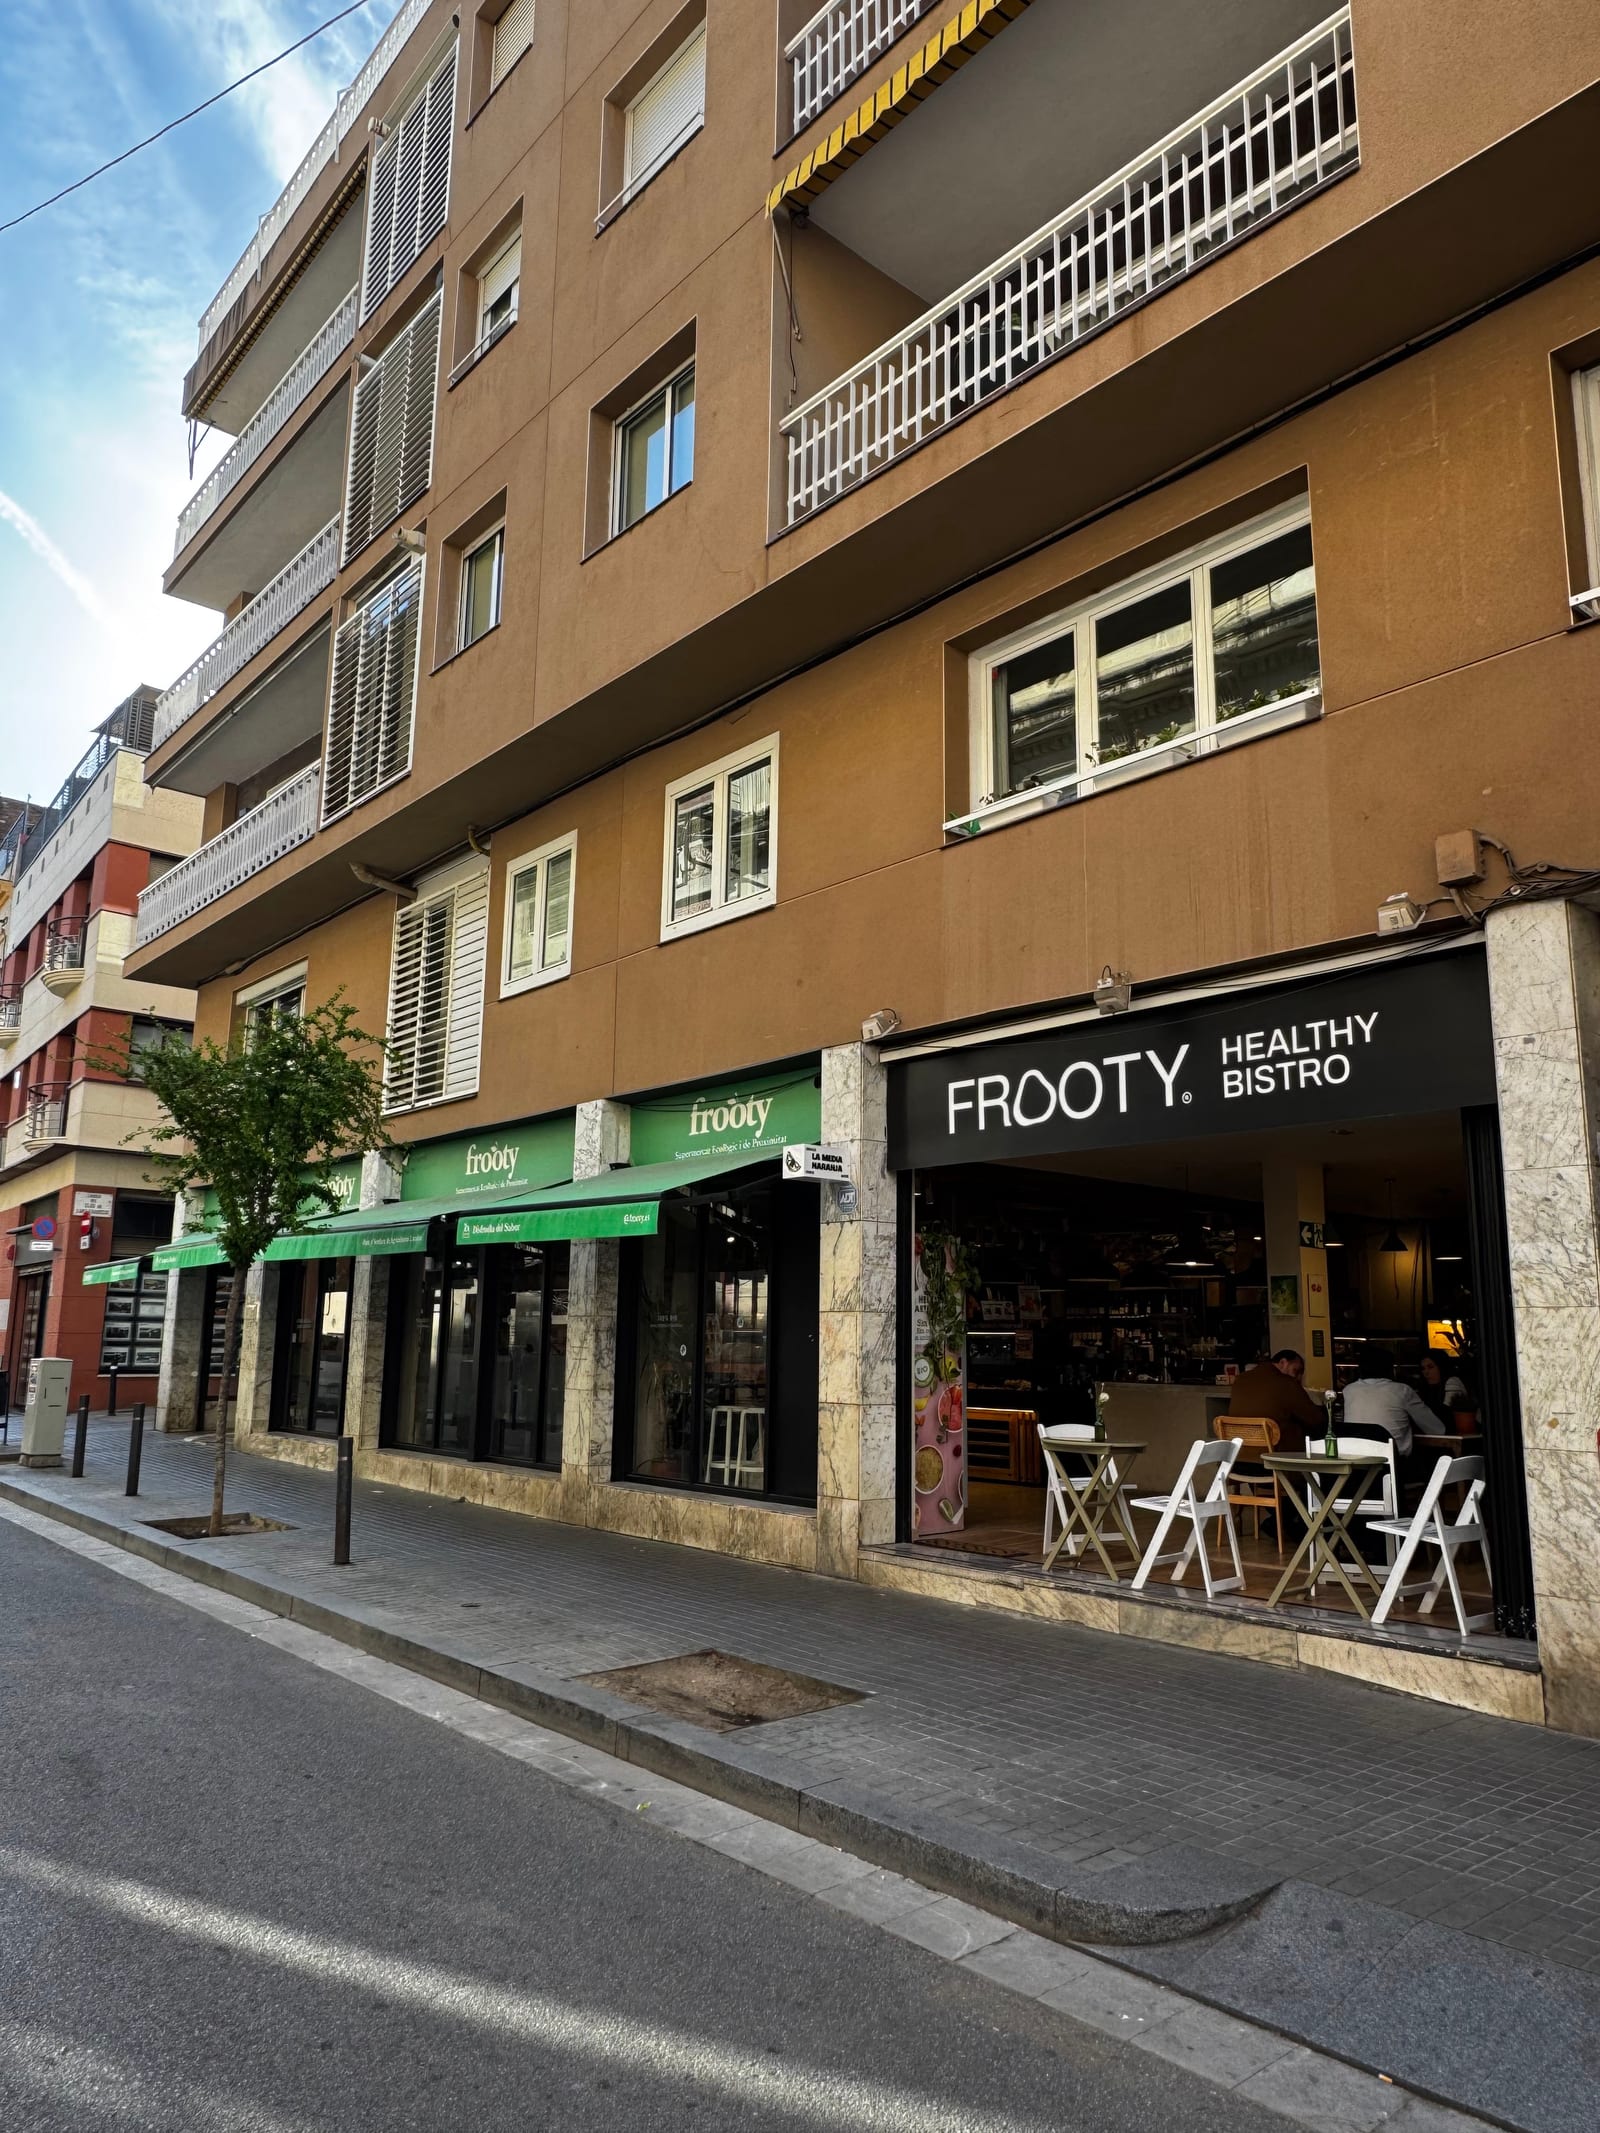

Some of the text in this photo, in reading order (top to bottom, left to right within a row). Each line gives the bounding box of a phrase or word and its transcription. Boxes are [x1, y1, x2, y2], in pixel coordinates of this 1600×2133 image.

[1221, 1012, 1379, 1065] HEALTHY
[1223, 1054, 1351, 1099] BISTRO
[689, 1093, 773, 1138] frooty
[465, 1141, 520, 1180] frooty
[811, 1162, 842, 1172] NARANJA
[812, 1153, 843, 1163] LA MEDIA
